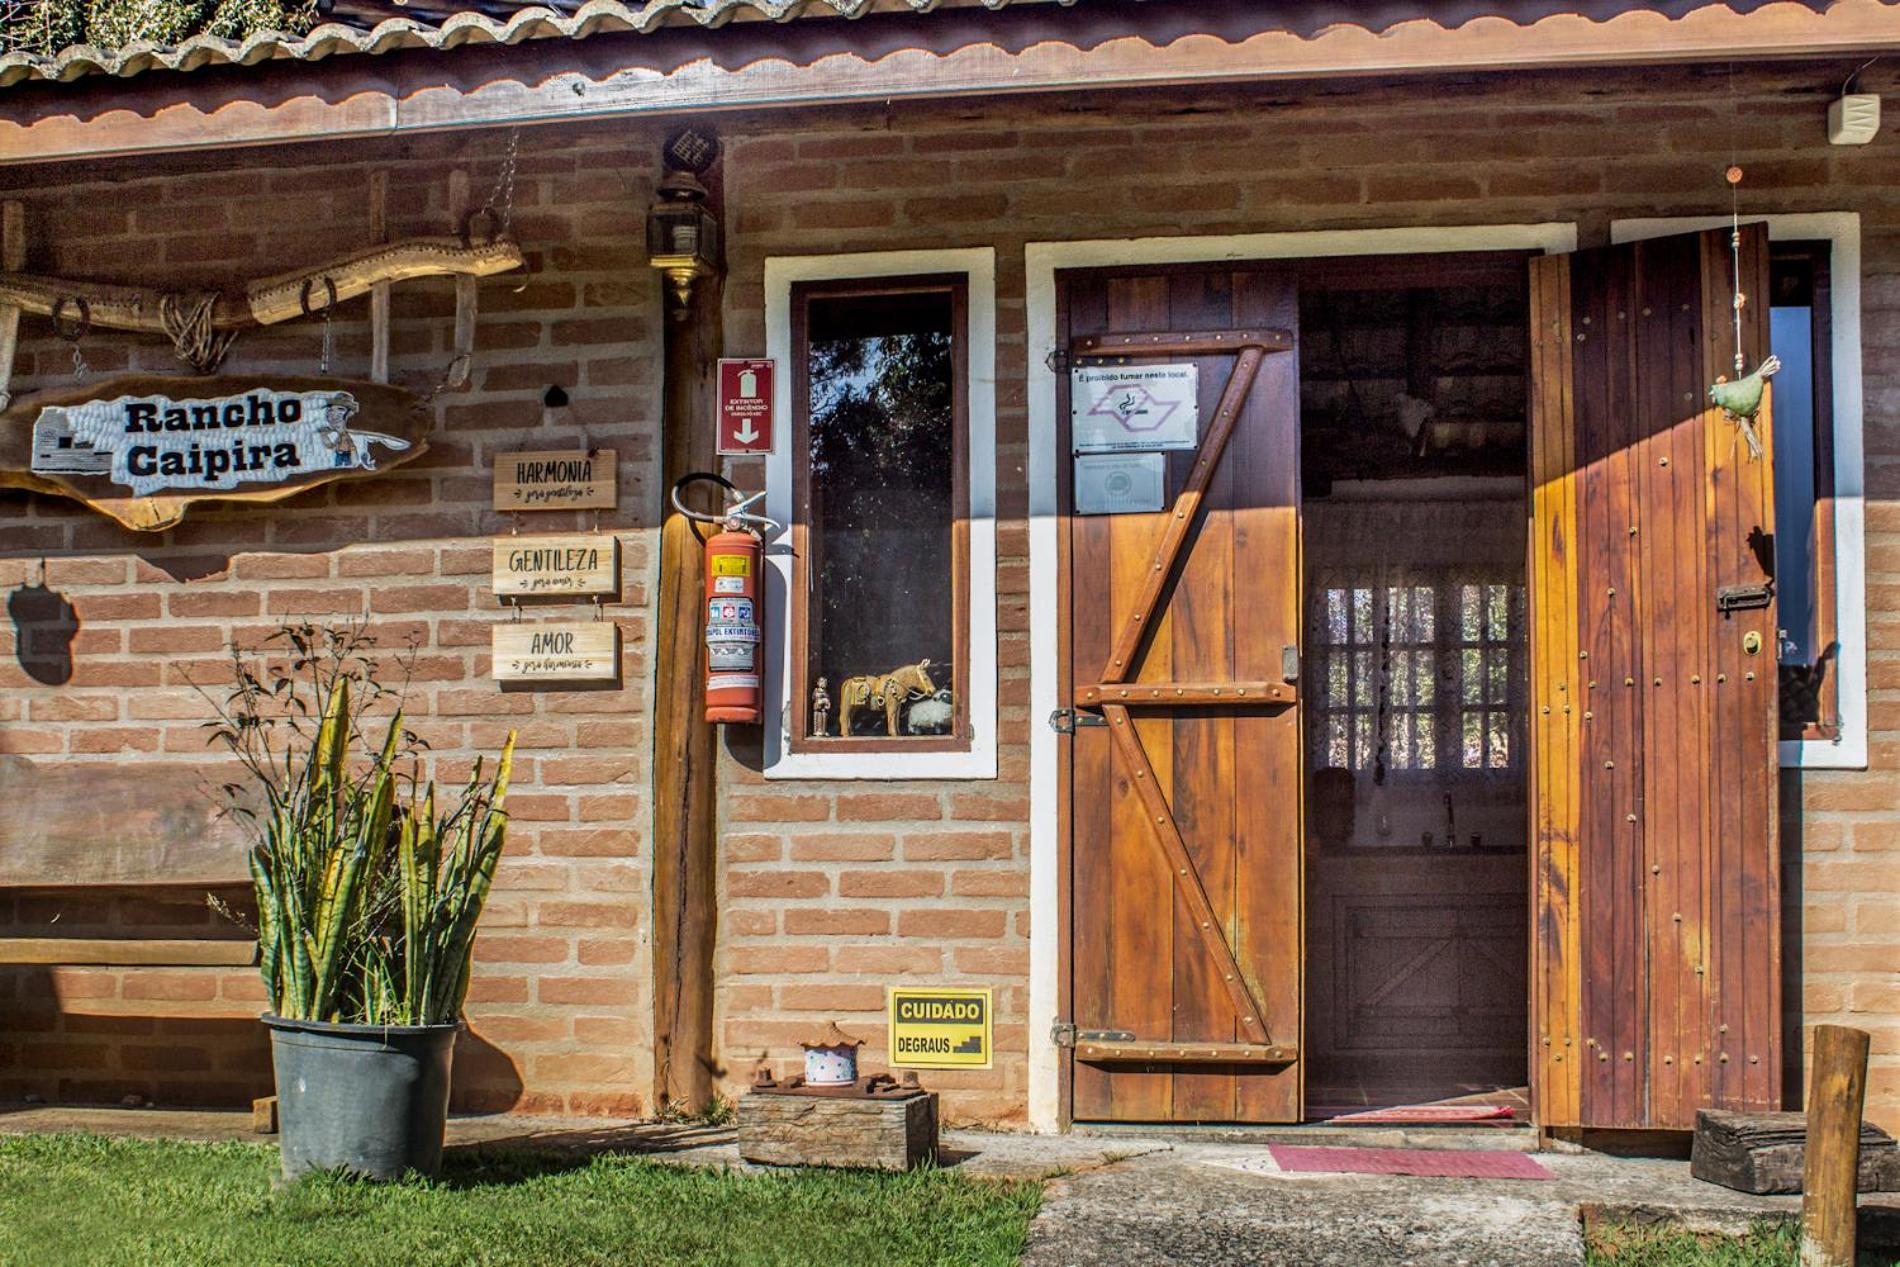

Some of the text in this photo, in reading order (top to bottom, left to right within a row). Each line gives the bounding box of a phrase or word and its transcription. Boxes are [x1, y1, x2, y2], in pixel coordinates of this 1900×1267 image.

[1086, 372, 1119, 382] proibido
[1120, 372, 1144, 380] fumar
[1145, 371, 1166, 379] neste
[125, 395, 302, 433] Rancho
[127, 440, 301, 482] Caipira
[517, 460, 592, 484] HARMONIA
[509, 548, 598, 573] GENTILEZA
[531, 631, 574, 655] AMOR
[900, 1002, 980, 1019] CUIDADO
[898, 1037, 950, 1053] DEGRAUS
